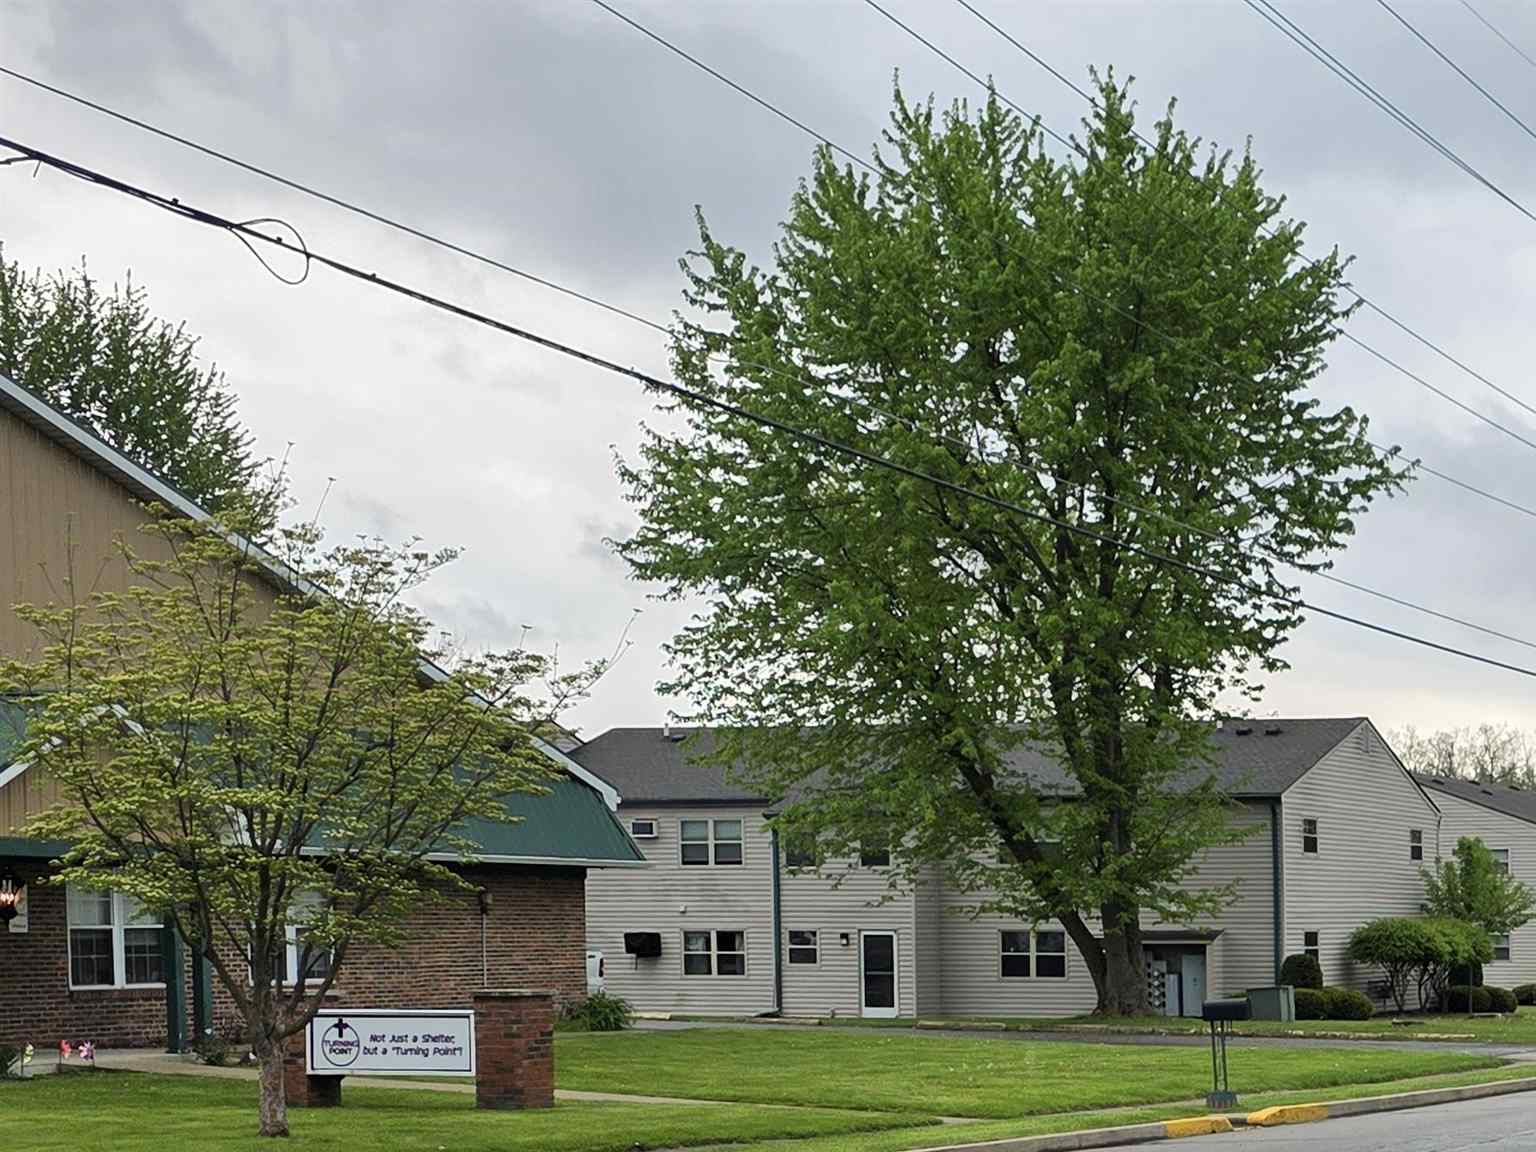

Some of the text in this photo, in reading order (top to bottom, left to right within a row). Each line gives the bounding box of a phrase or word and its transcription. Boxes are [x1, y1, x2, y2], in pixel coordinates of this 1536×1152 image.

[369, 1033, 386, 1043] Not
[390, 1033, 408, 1043] Just
[412, 1035, 418, 1043] a
[329, 1047, 353, 1055] POINT
[362, 1046, 378, 1055] but
[381, 1047, 388, 1055] a
